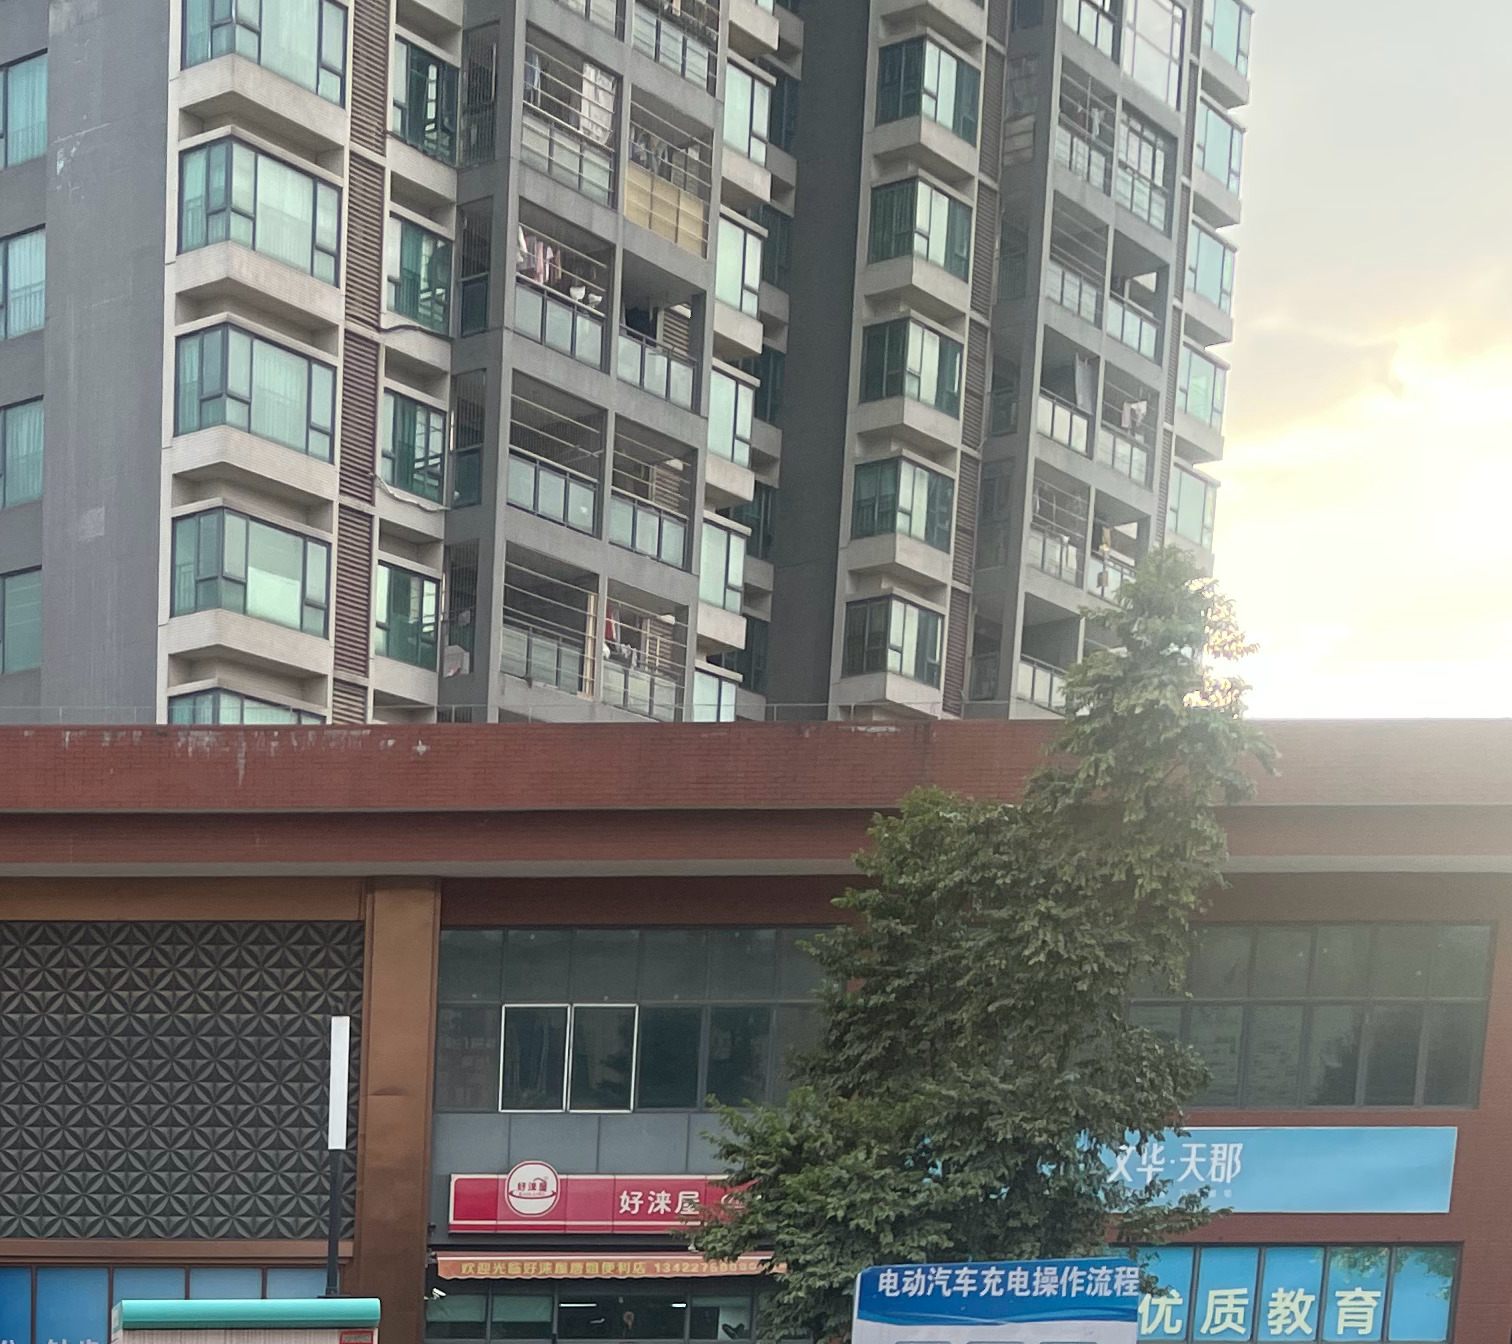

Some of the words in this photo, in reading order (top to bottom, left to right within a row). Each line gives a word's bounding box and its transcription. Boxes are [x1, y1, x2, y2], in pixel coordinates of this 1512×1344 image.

[619, 1190, 700, 1215] 好涞屋
[878, 1265, 1140, 1298] 电动汽车充电操作流程
[1138, 1287, 1381, 1335] 优质教育
